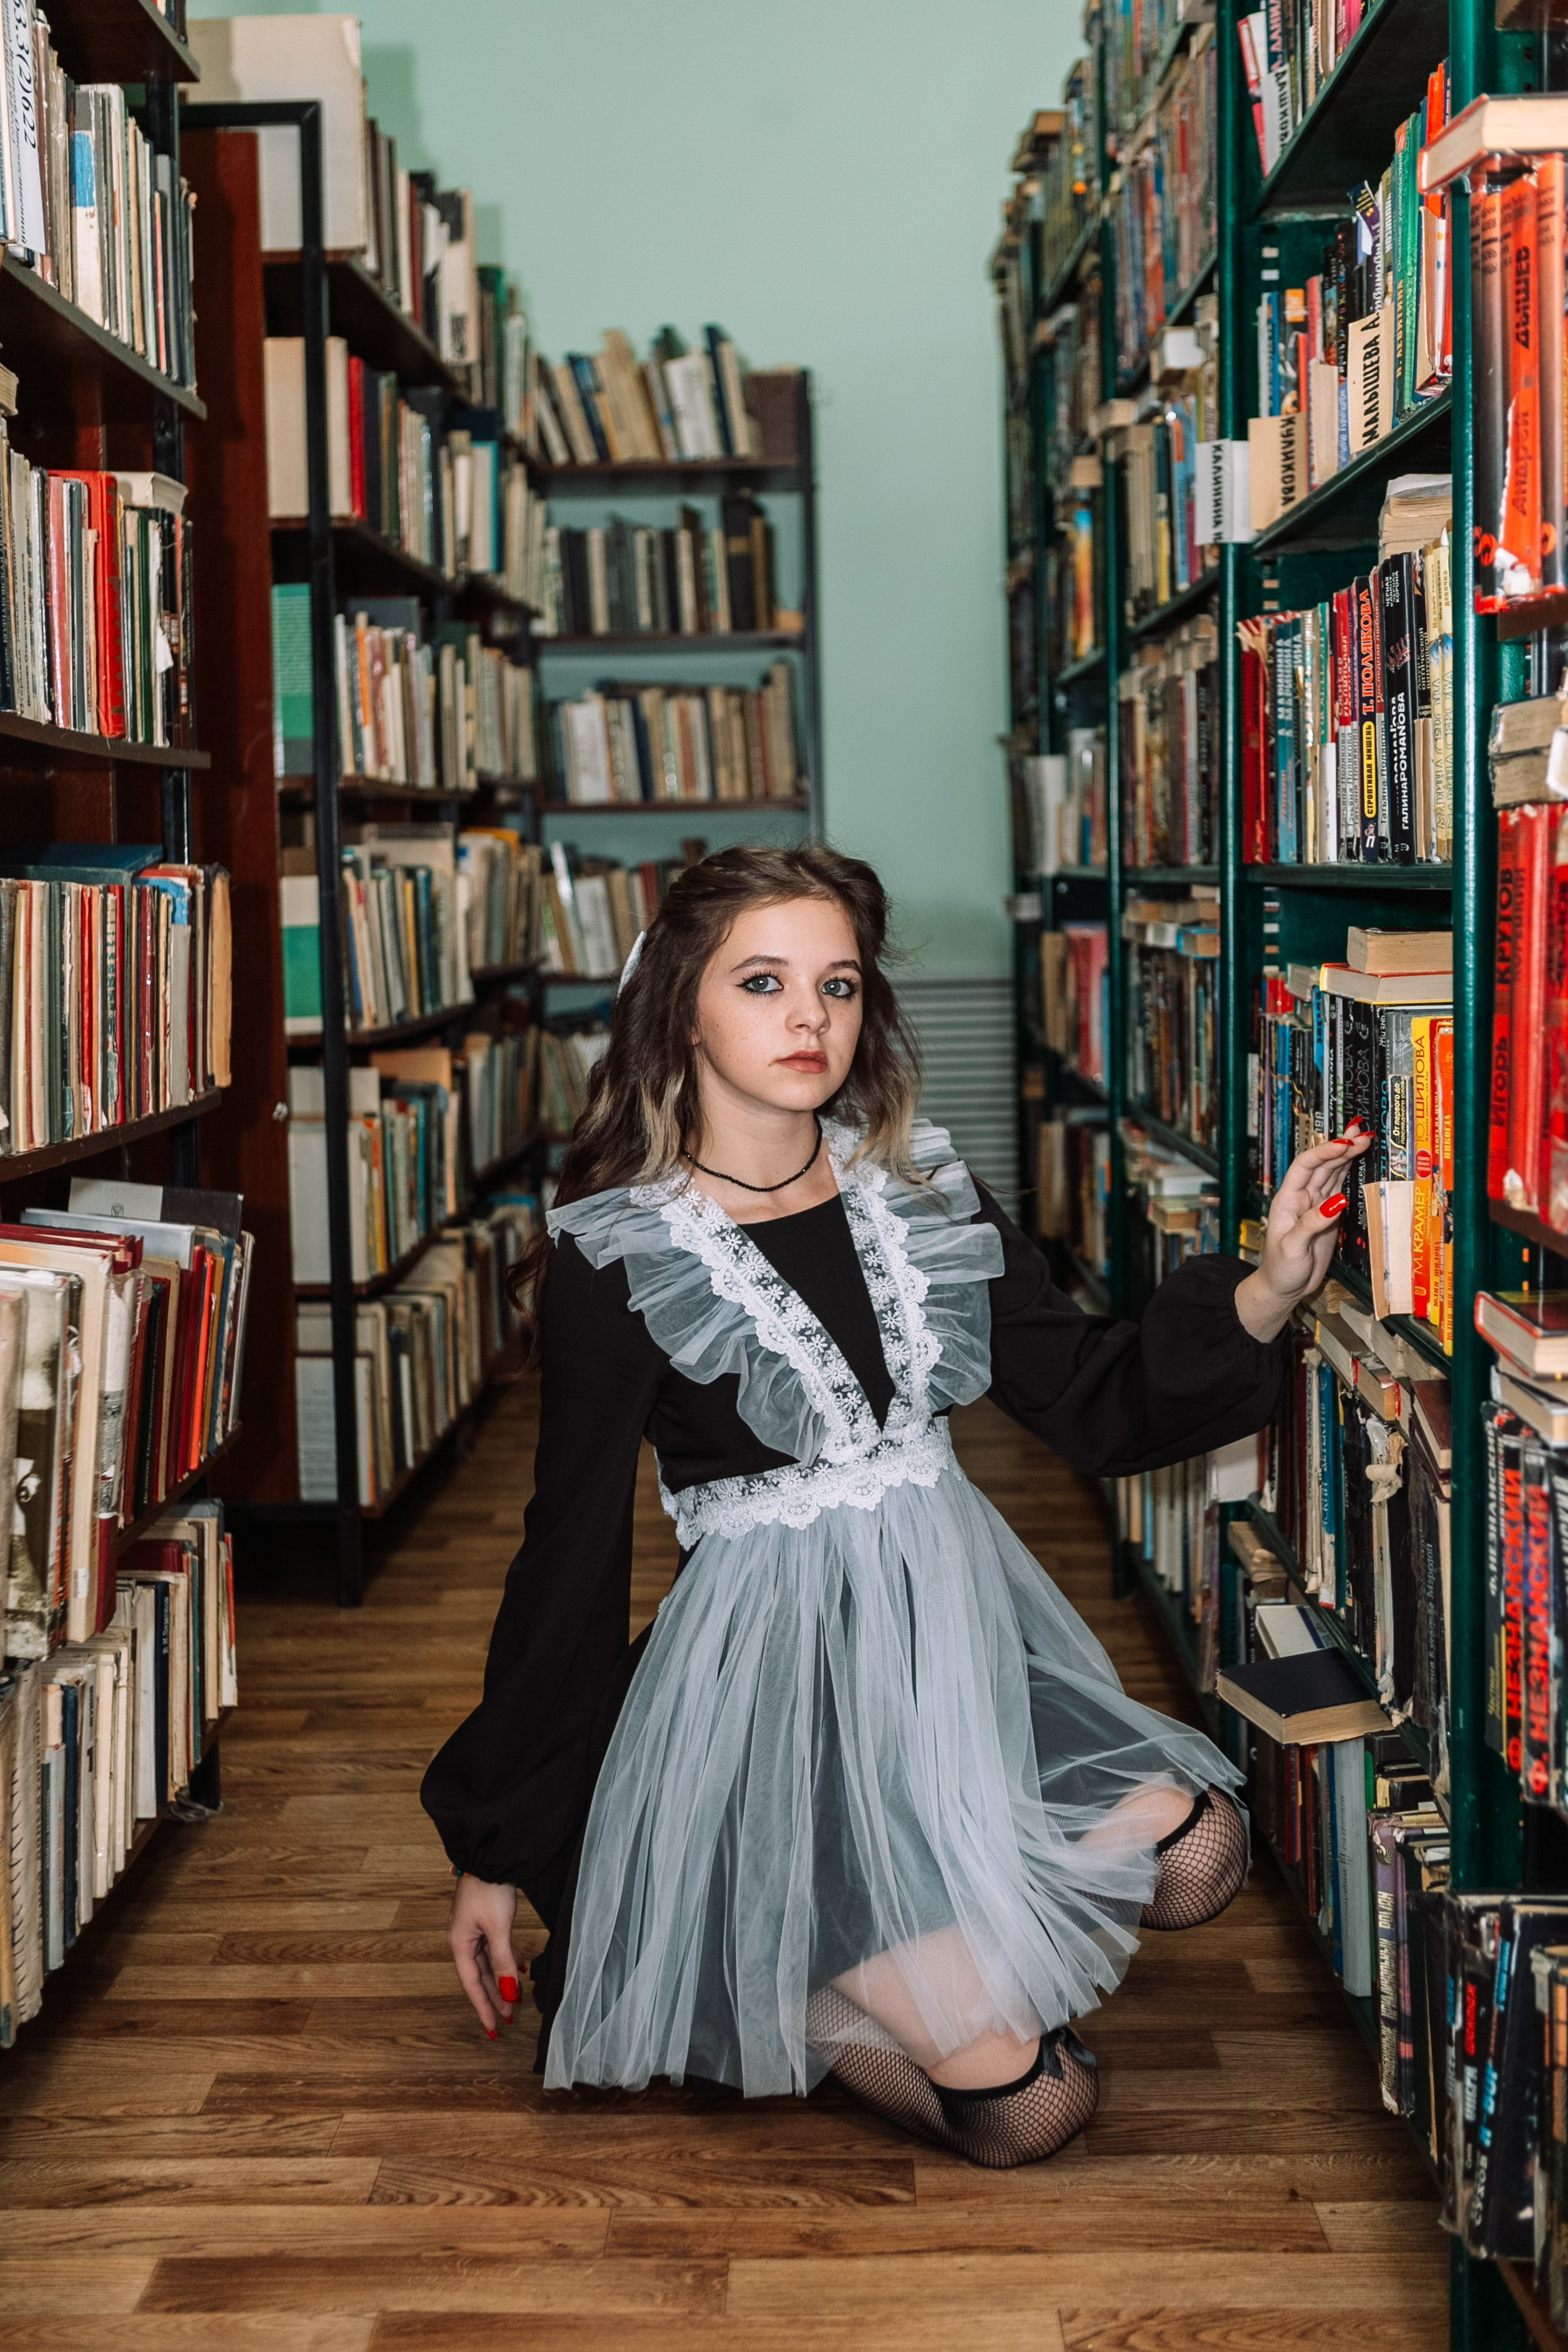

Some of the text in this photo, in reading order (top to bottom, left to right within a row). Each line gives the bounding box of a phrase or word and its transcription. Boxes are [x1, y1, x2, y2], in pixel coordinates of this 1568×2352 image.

[14, 118, 28, 245] Отечественной
[1516, 245, 1531, 350] ДЫШЕВ
[1360, 312, 1381, 447] МАЛЫШЕВА А.
[1212, 443, 1224, 528] КАЛИНИНА
[1280, 415, 1296, 506] КУЛИКОВА
[1511, 412, 1532, 516] Андрей
[1276, 638, 1286, 719] МАРИНИНА
[1284, 638, 1293, 721] МАРИНИНА
[1359, 588, 1374, 716] Т. ПОЛЯКОВА
[1418, 627, 1426, 691] оптической
[1363, 725, 1374, 814] СТРОПТИВАЯ МИШЕНЬ
[1491, 869, 1512, 1127] Игорь КРУТОВ
[1393, 1083, 1402, 1136] От первого до
[1414, 1035, 1425, 1142] Ю. ШИЛОВА
[1442, 1114, 1452, 1160] НИКОГДА
[1413, 1186, 1425, 1275] М. КРАМЕР
[1319, 1402, 1328, 1472] ДЕТЕКТИВ
[1484, 1419, 1497, 1573] НЕЗНАНСКИЙ
[1525, 1484, 1549, 1795] Ф. НЕЗНАНСКИЙ
[1487, 1666, 1496, 1716] Частное
[1377, 1890, 1395, 1930] РОМАН
[1378, 1937, 1397, 2020] КРИМИНАЛЬНЫЙ
[1473, 2154, 1488, 2226] СУХОВ
